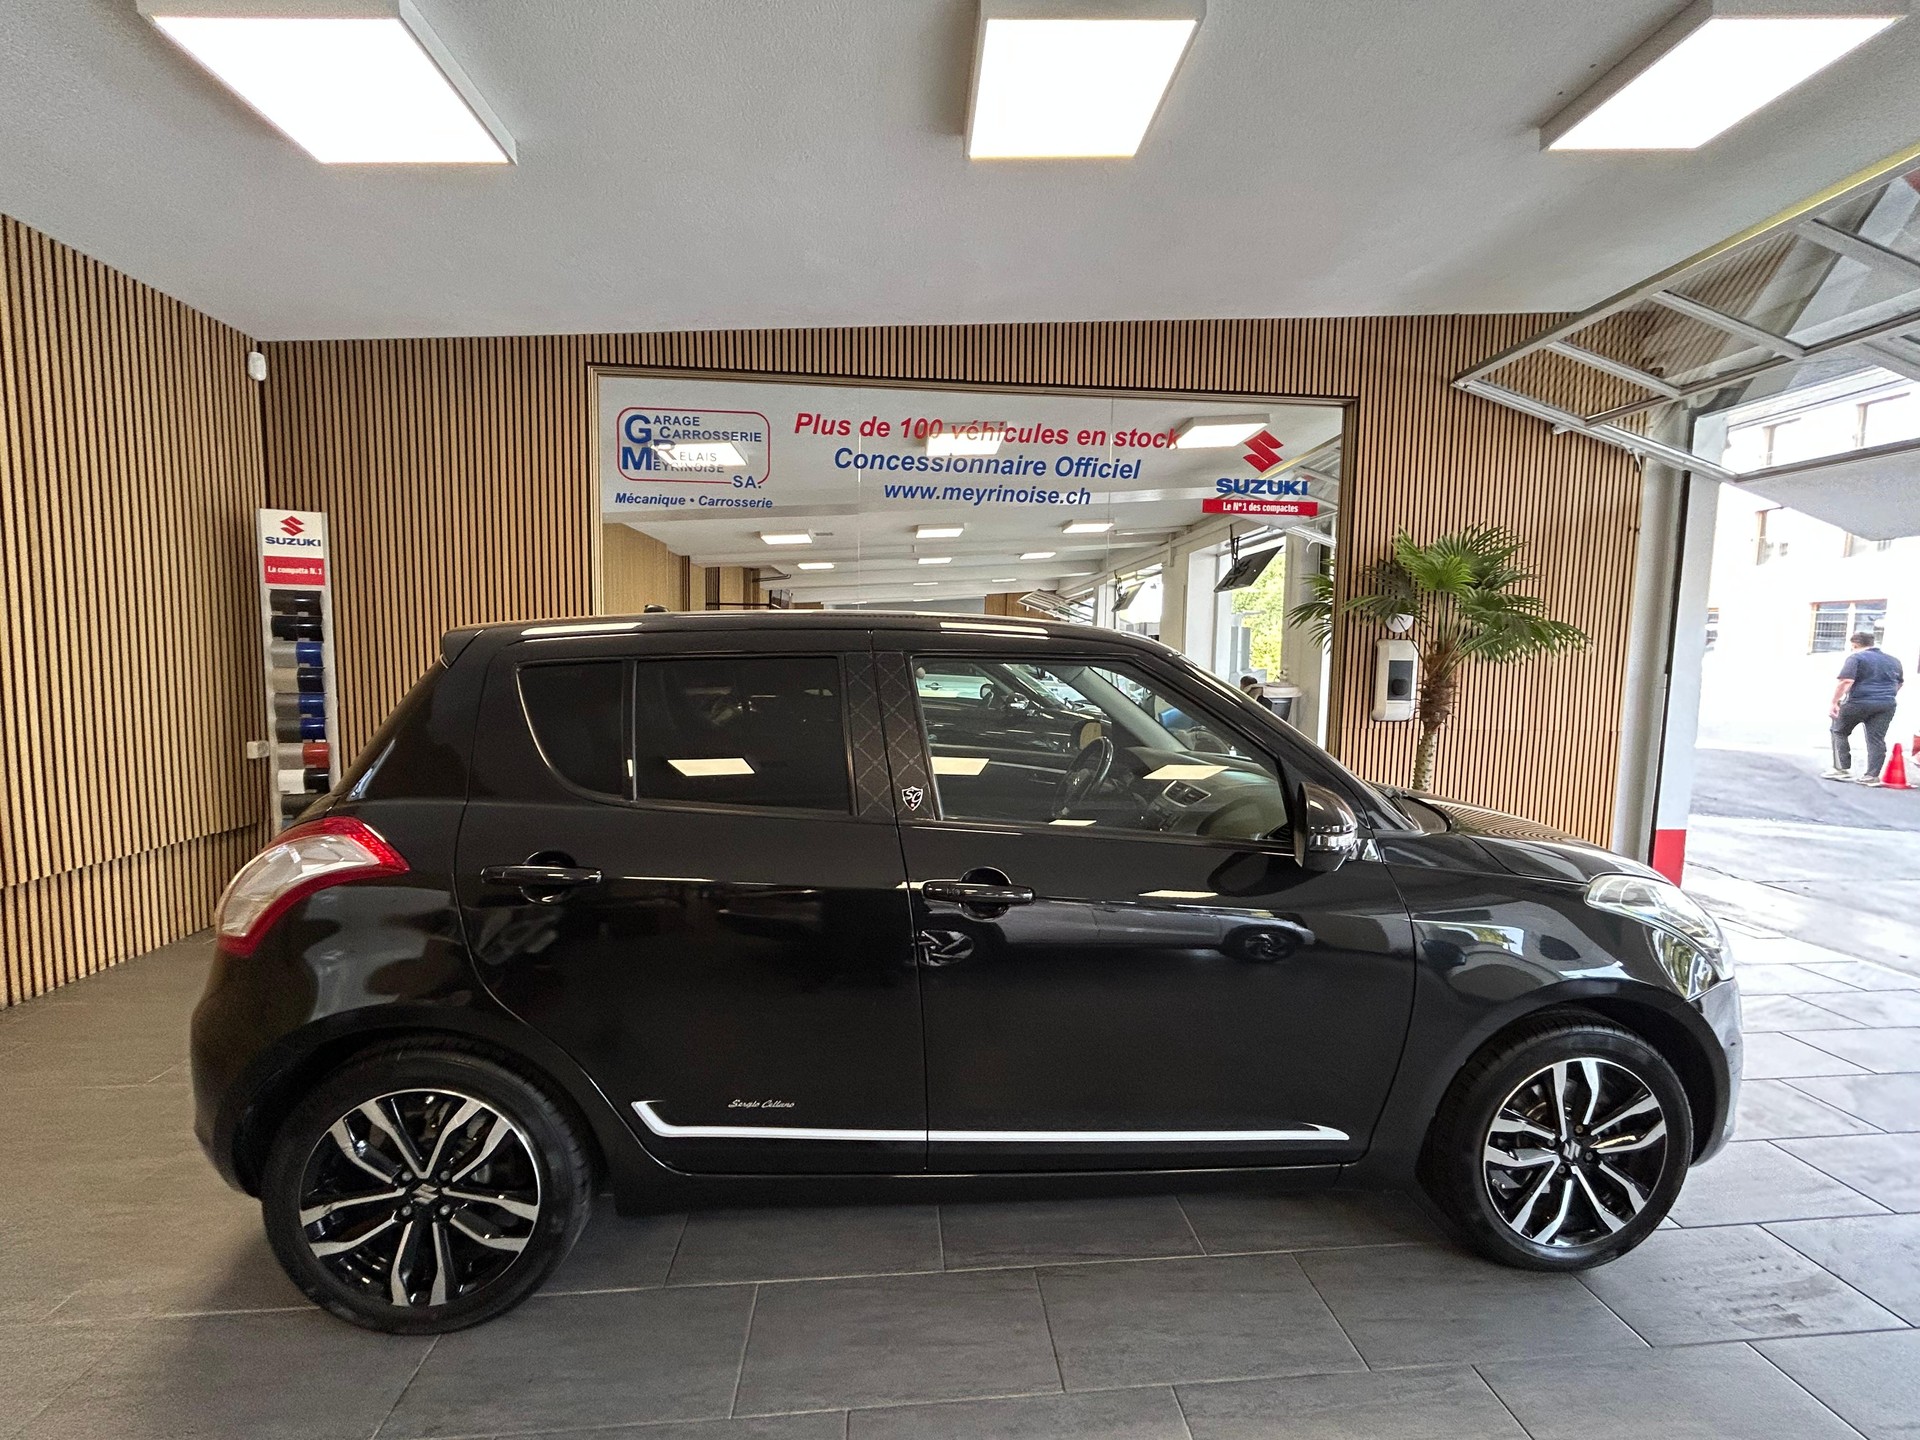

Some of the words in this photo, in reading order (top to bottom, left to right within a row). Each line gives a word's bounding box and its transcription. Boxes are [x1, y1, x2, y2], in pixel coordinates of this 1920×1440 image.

[660, 426, 762, 442] CARROSSERIE
[794, 413, 851, 436] Plus
[859, 416, 891, 437] de
[900, 417, 943, 439] 100
[951, 420, 1069, 445] véhicules
[1077, 429, 1106, 446] en
[1113, 427, 1181, 449] stock
[834, 448, 1047, 477] Concessionnaire
[1055, 456, 1142, 479] Officiel
[884, 484, 1091, 506] www.meyrinoise.ch
[1216, 478, 1308, 496] SUZUKI
[615, 492, 686, 507] Mécanique
[699, 495, 773, 508] Carrosserie
[1222, 502, 1231, 511] Le
[1248, 502, 1261, 512] des
[1262, 503, 1299, 514] compactes
[265, 536, 321, 547] SUZUKI
[267, 565, 277, 573] La
[728, 1099, 760, 1109] Sergio
